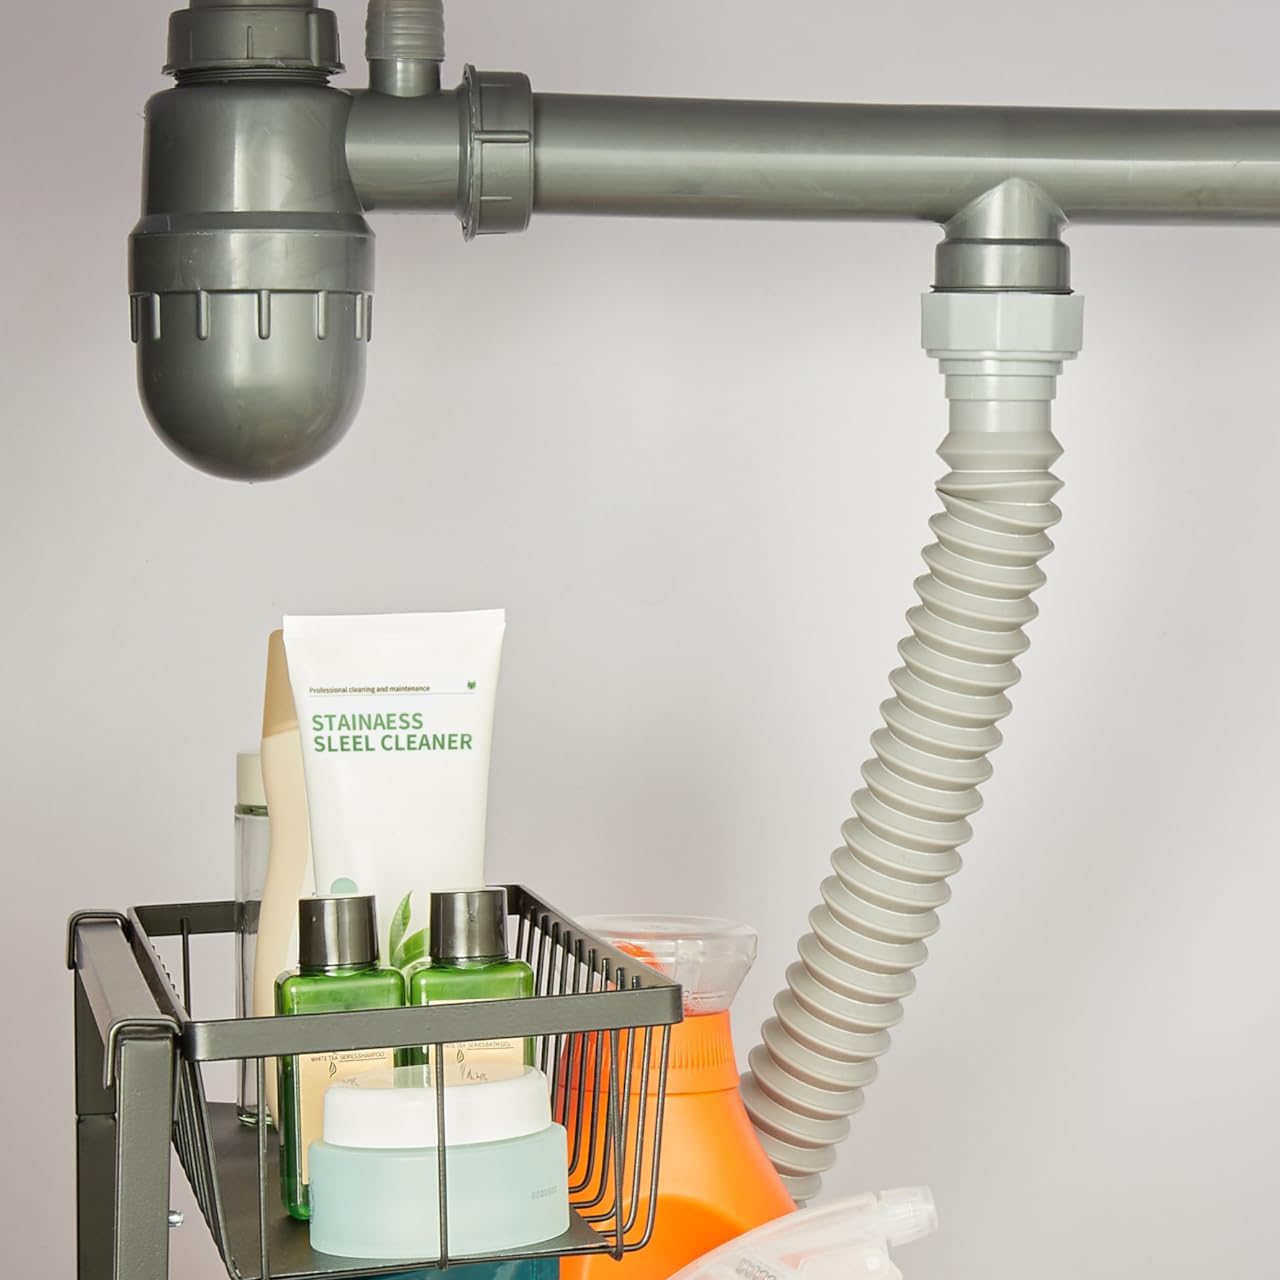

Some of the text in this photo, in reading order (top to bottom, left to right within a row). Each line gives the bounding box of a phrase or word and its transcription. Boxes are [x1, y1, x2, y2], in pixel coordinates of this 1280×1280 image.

[309, 685, 430, 695] Professional cleaning and maintenance
[311, 712, 424, 732] STAINAESS
[313, 733, 473, 752] SLEEL CLEANER
